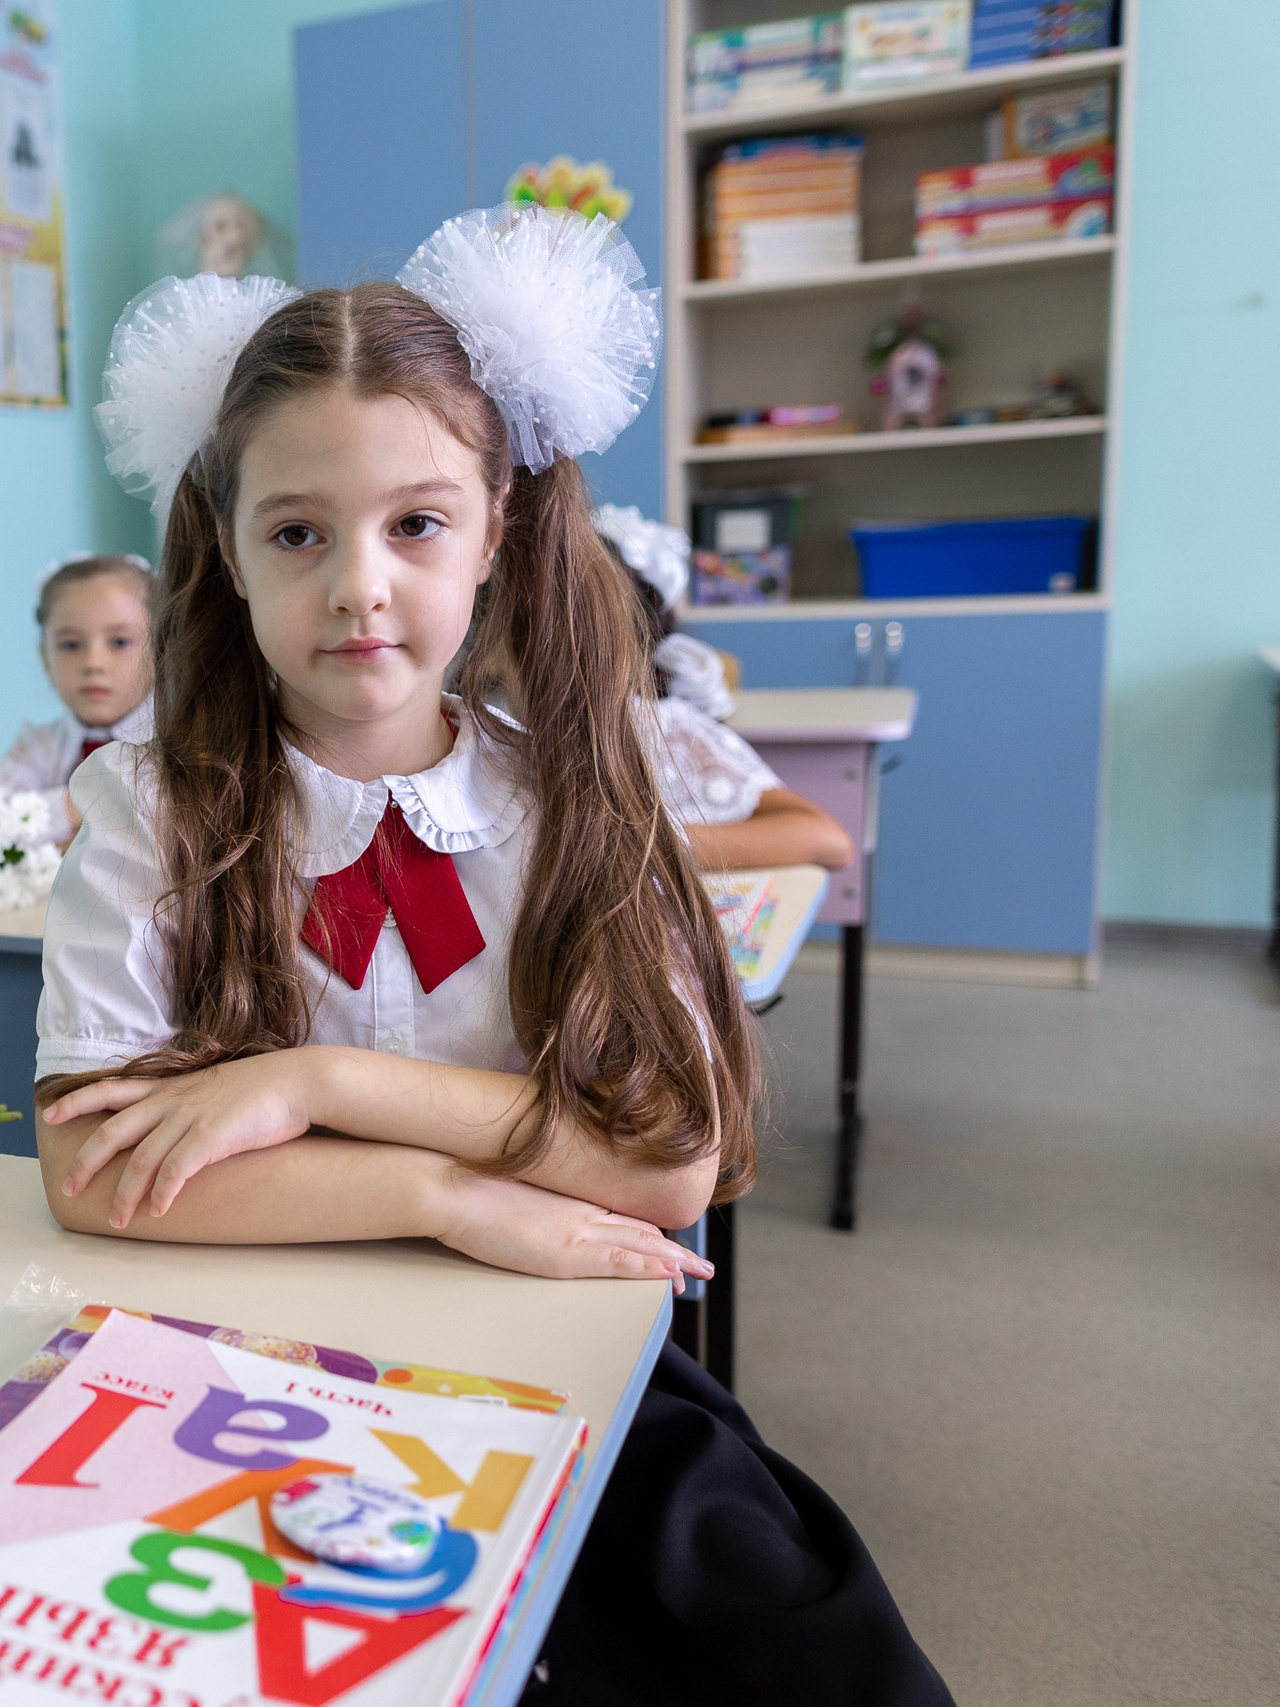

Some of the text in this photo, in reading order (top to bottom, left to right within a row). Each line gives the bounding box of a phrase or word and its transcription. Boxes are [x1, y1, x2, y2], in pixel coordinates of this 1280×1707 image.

[94, 1369, 177, 1401] класс
[283, 1381, 394, 1418] Часть 1
[14, 1382, 168, 1488] 1
